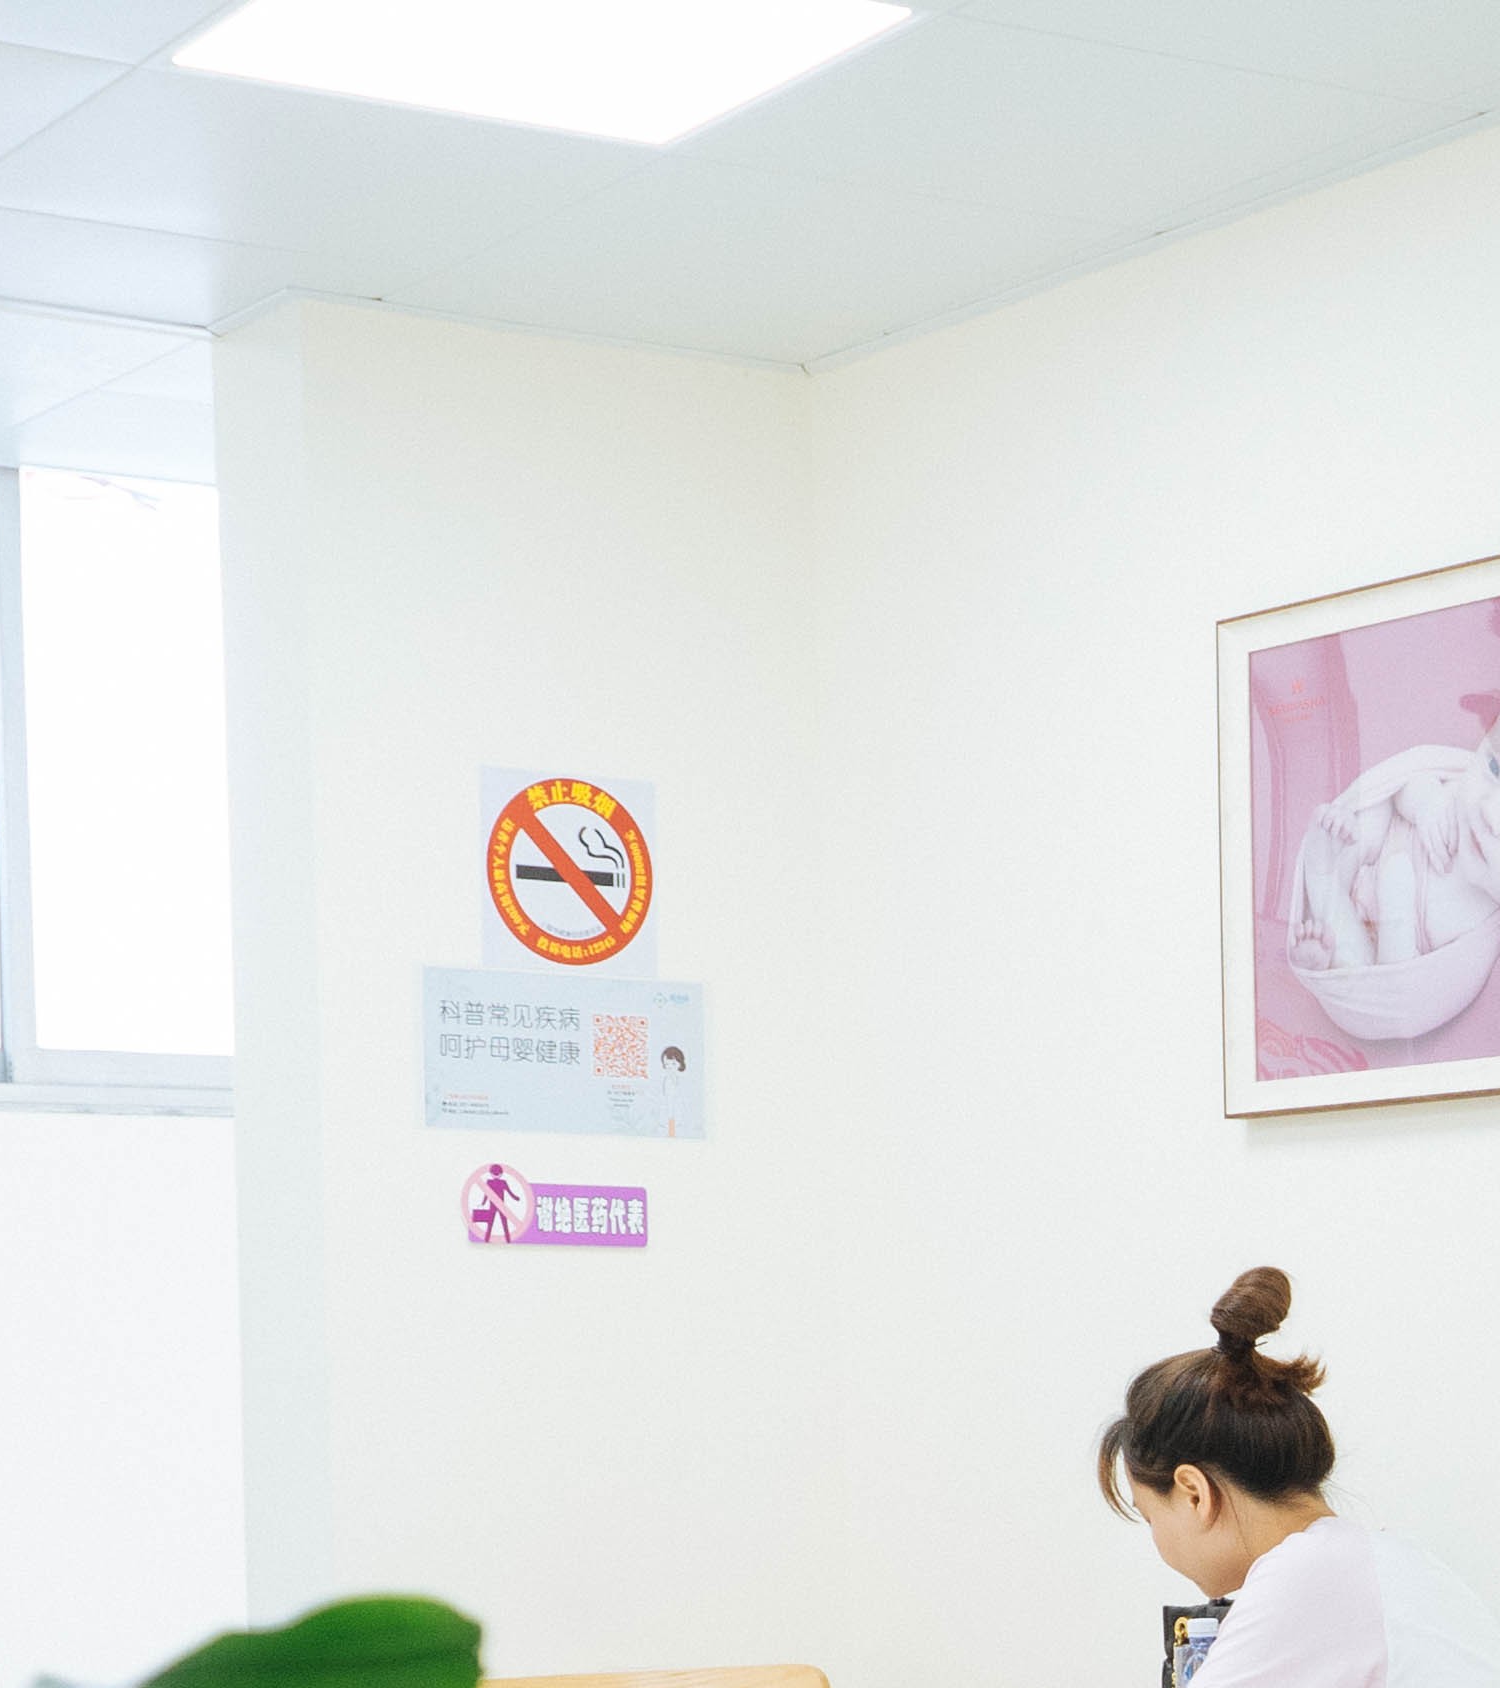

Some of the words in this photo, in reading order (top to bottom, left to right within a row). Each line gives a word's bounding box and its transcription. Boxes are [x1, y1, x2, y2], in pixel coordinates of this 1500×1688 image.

[527, 780, 618, 820] 禁止吸烟
[439, 1000, 580, 1031] 科普常见疾病
[440, 1034, 580, 1065] 呵护母婴健康
[536, 1196, 644, 1235] 谢绝医药代表
